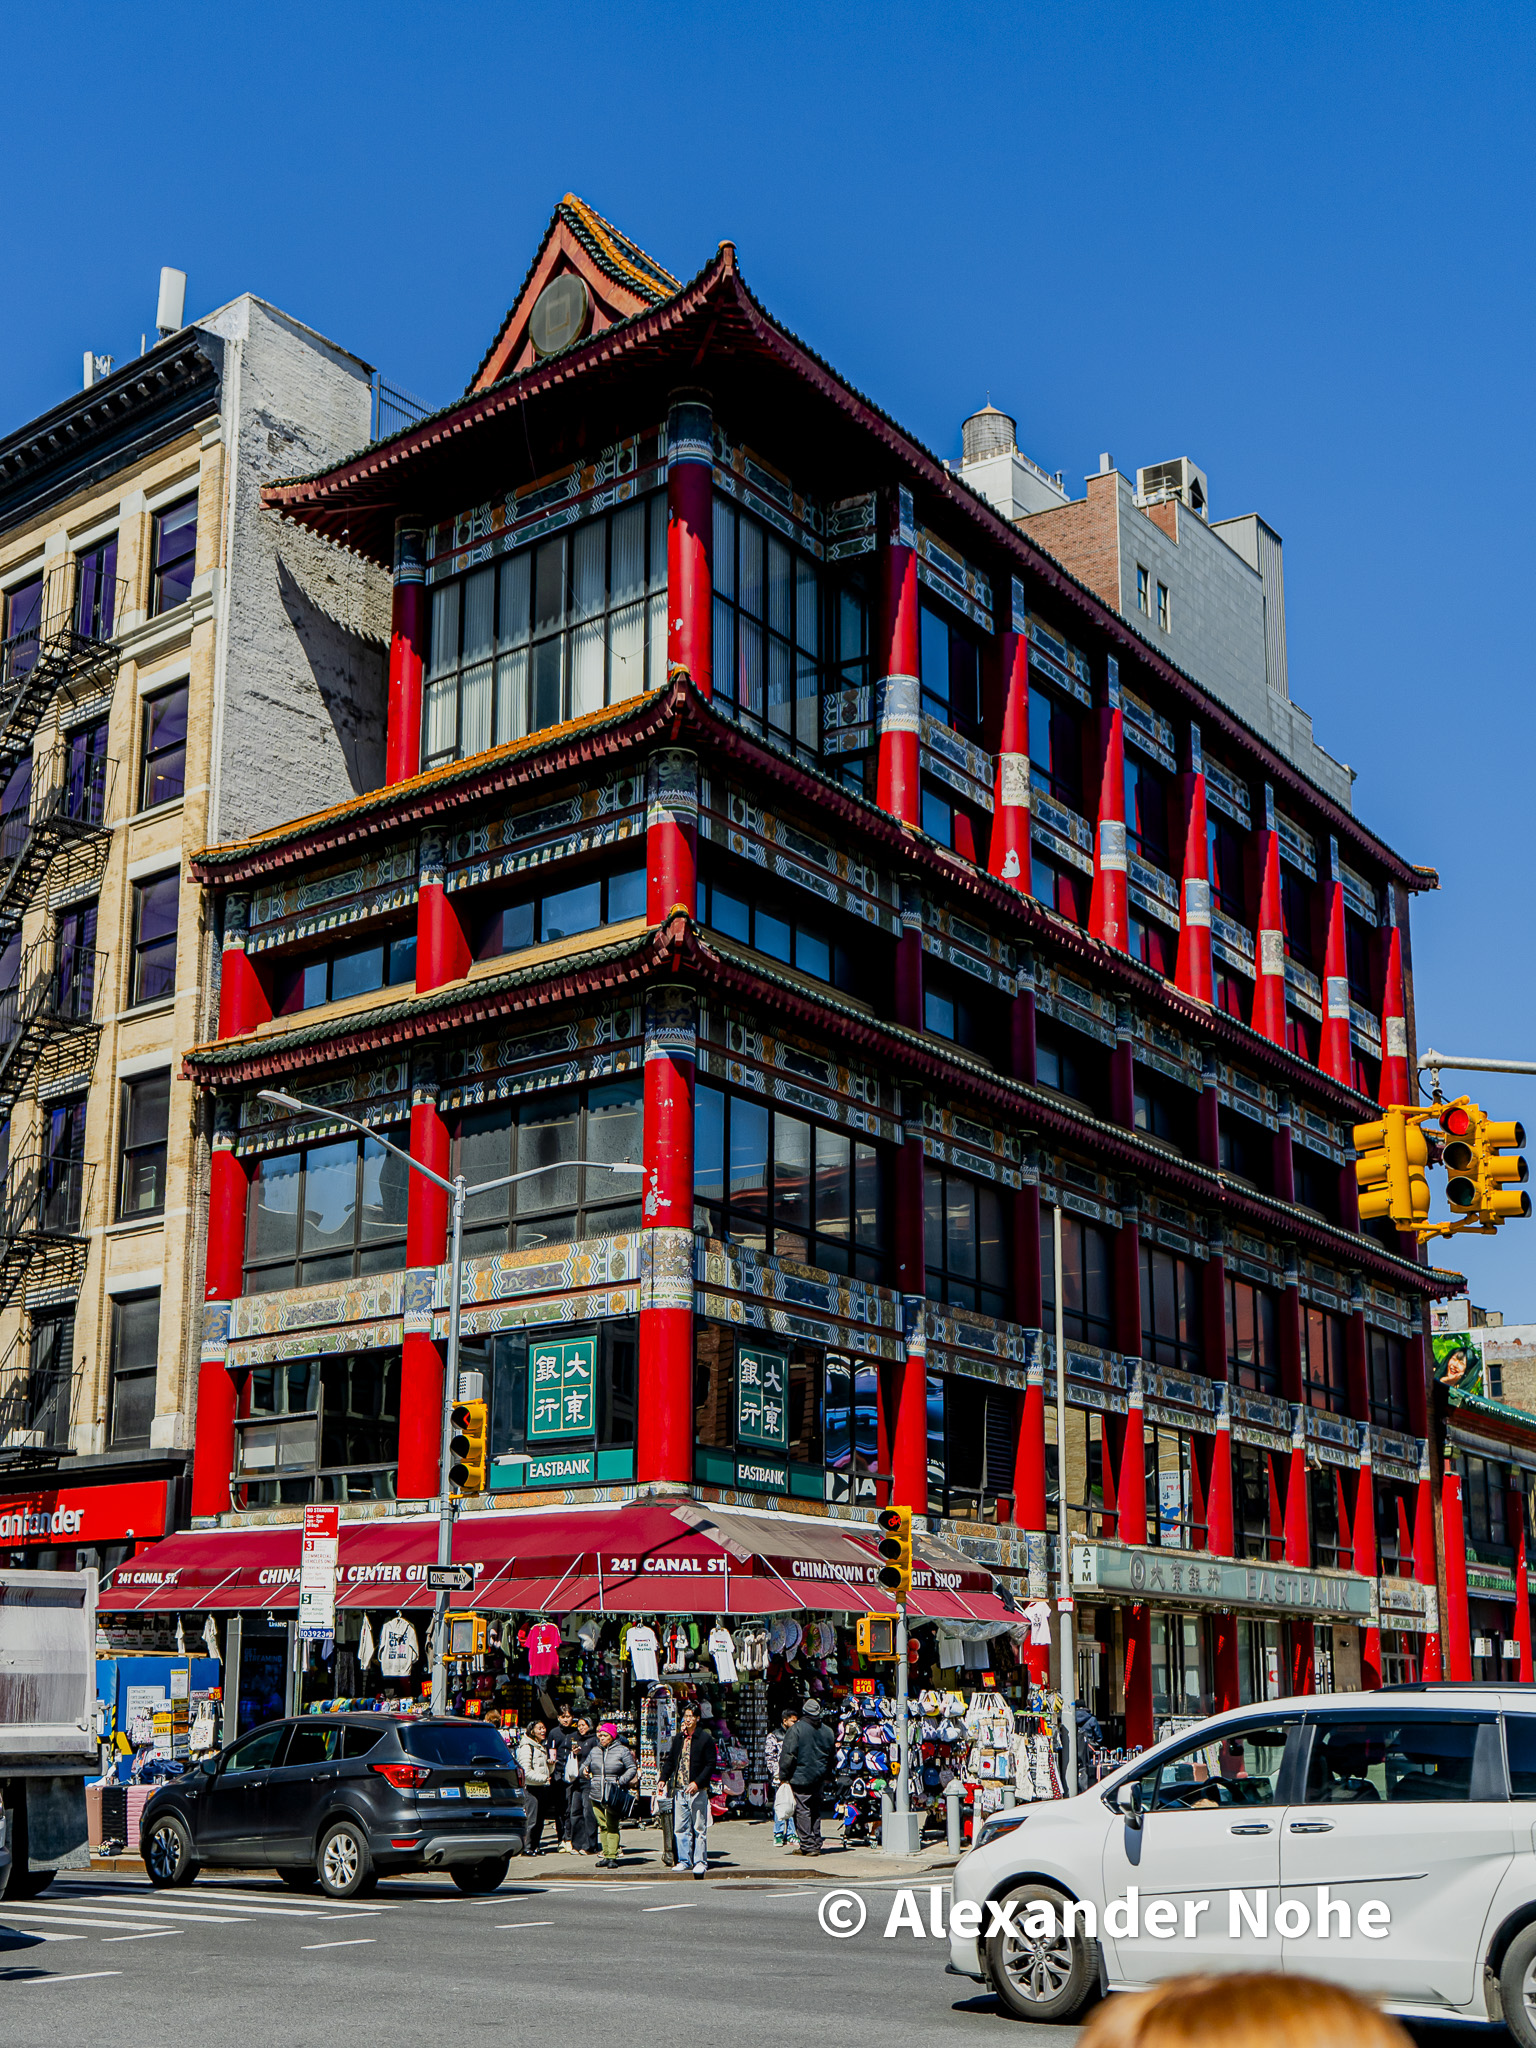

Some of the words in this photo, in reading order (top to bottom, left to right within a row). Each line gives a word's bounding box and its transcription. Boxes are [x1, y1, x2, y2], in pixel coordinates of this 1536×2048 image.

[529, 1458, 591, 1478] EASTBANK
[738, 1463, 785, 1486] EASTBANK
[306, 1541, 313, 1551] 3
[611, 1558, 638, 1572] 241
[643, 1558, 702, 1572] CANAL
[707, 1558, 732, 1572] ST.
[1082, 1547, 1092, 1582] ATM
[117, 1572, 132, 1584] 241
[133, 1572, 163, 1584] CANAL
[164, 1573, 178, 1584] ST.
[347, 1564, 402, 1582] CENTER
[432, 1573, 445, 1584] ONE
[453, 1573, 467, 1584] WAY
[792, 1560, 863, 1582] CHINATOWN
[934, 1573, 962, 1589] SHOP
[1246, 1569, 1350, 1611] EASTBANK
[303, 1594, 310, 1604] 5
[537, 1644, 552, 1654] NY
[856, 1685, 872, 1693] $10
